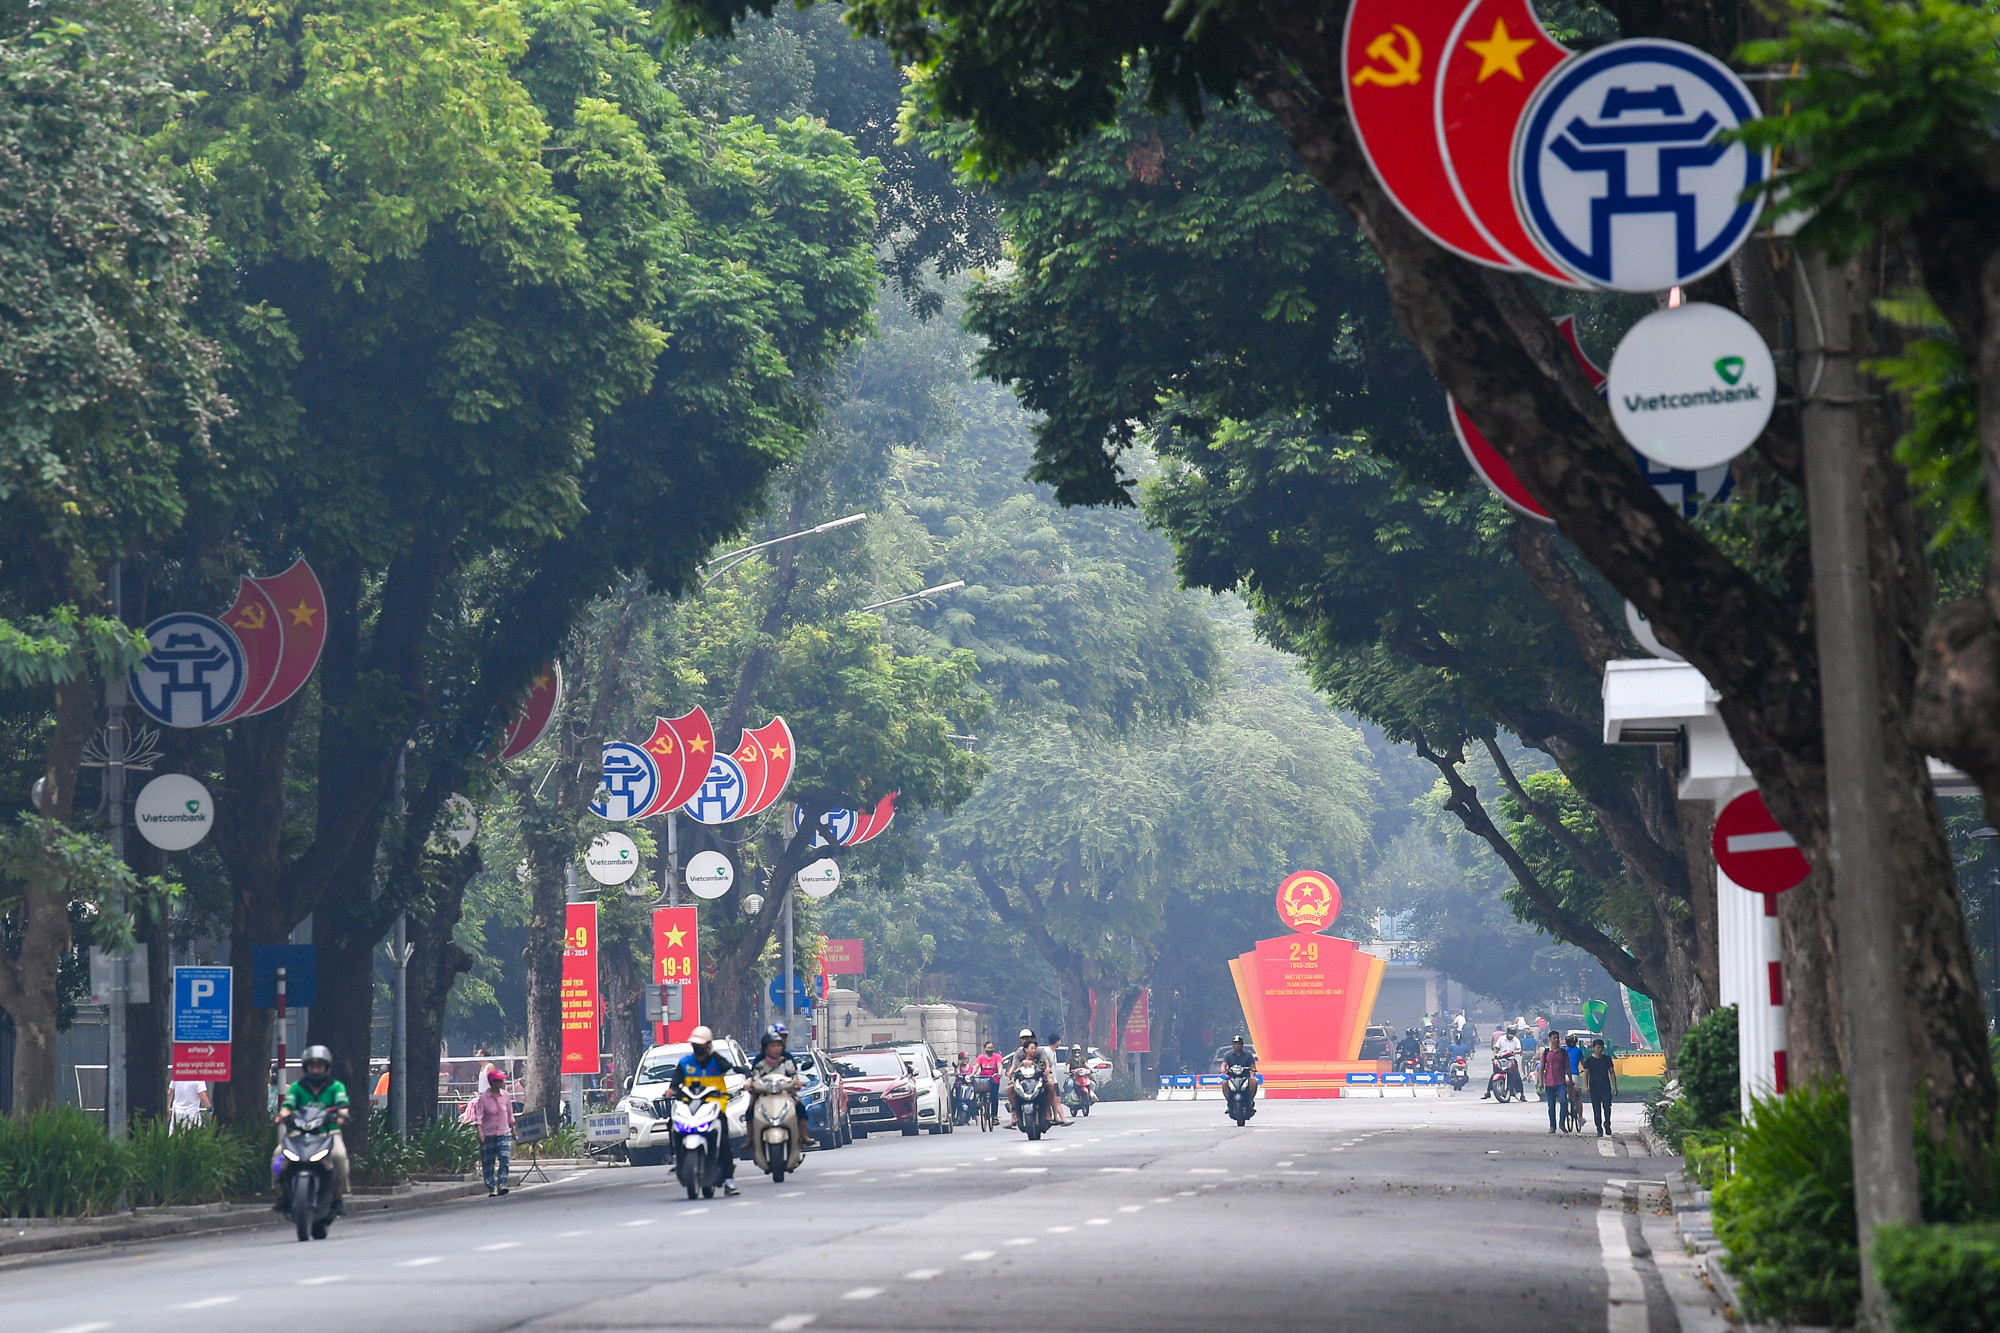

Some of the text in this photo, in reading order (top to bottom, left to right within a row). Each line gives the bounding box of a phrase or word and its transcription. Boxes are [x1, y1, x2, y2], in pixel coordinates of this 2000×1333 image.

[1624, 383, 1760, 412] Vietcombank
[142, 813, 206, 822] Vietcombank
[590, 858, 634, 866] Vietcombank
[1290, 943, 1318, 961] 2-9
[191, 980, 214, 1007] P
